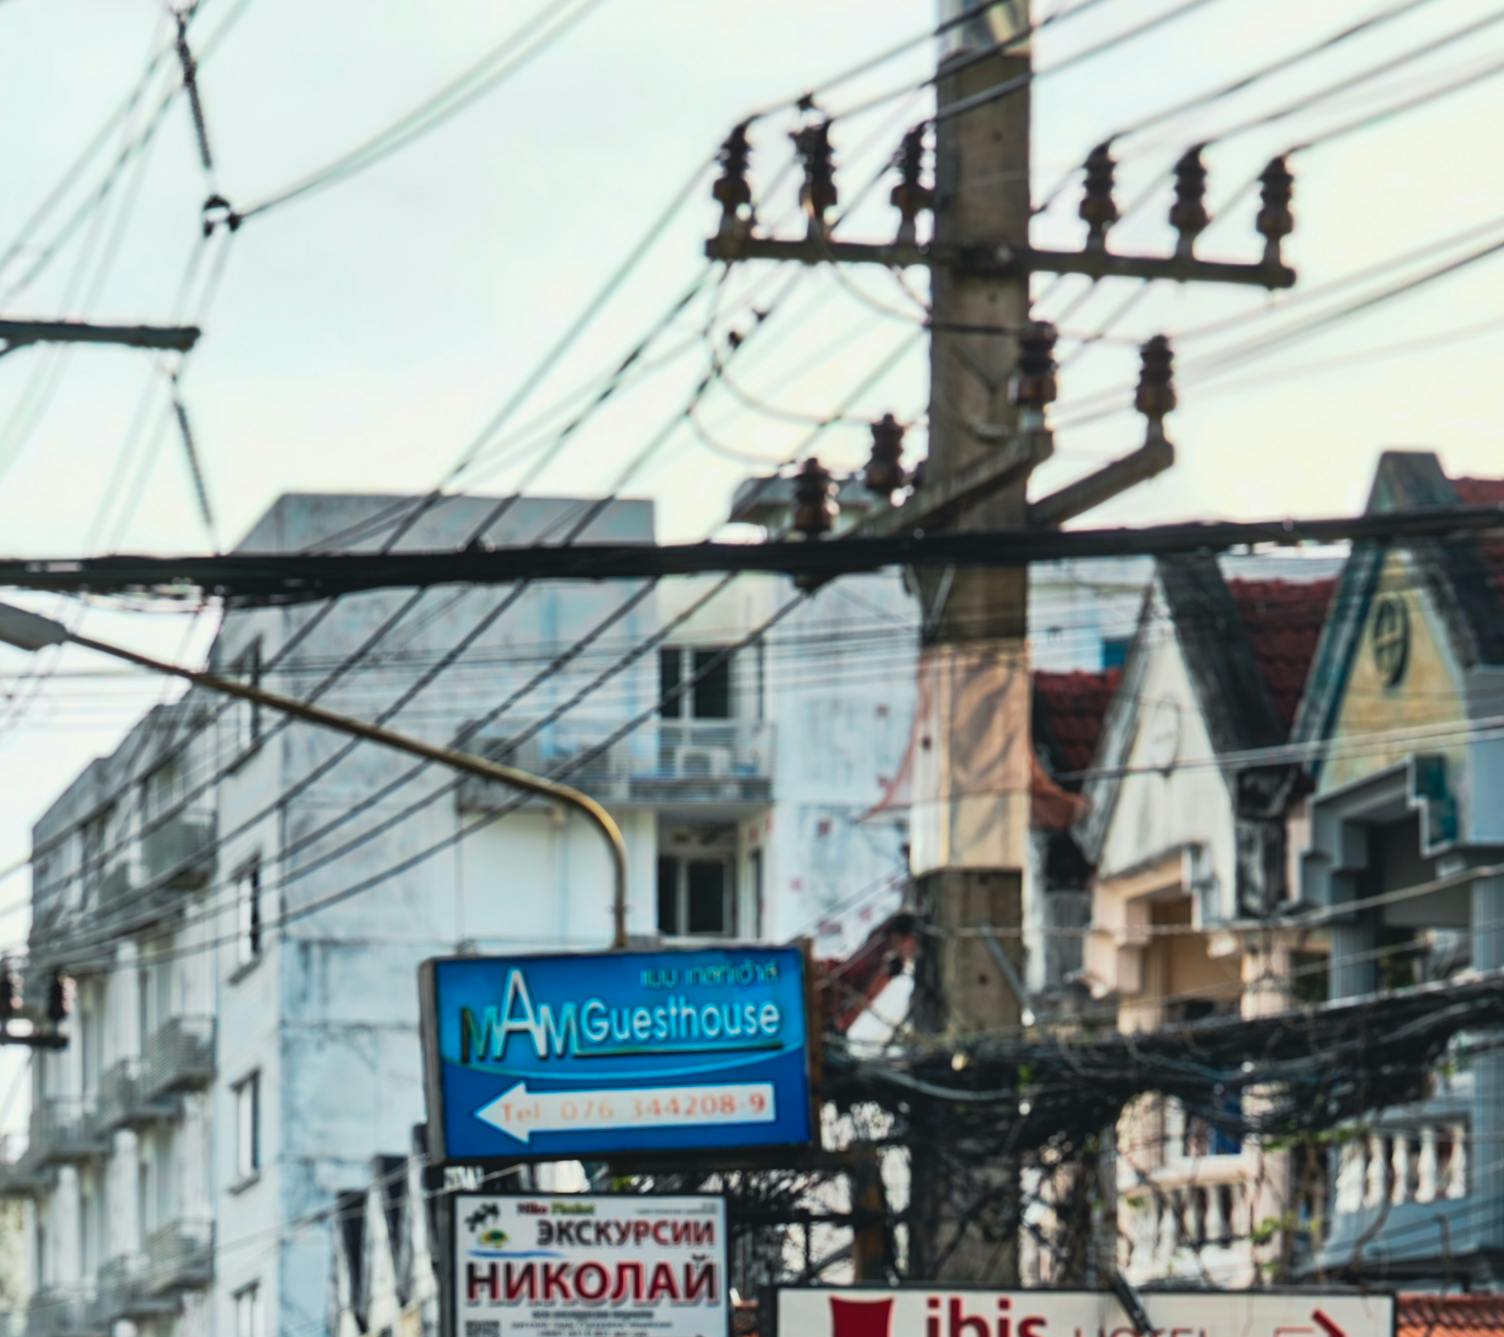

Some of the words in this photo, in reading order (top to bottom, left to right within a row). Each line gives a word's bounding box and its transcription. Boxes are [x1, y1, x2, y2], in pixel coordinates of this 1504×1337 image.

[579, 996, 780, 1042] Guesthouse
[536, 1220, 716, 1246] ЭКСКУРСИИ
[465, 1254, 719, 1304] НИКОЛАЙ
